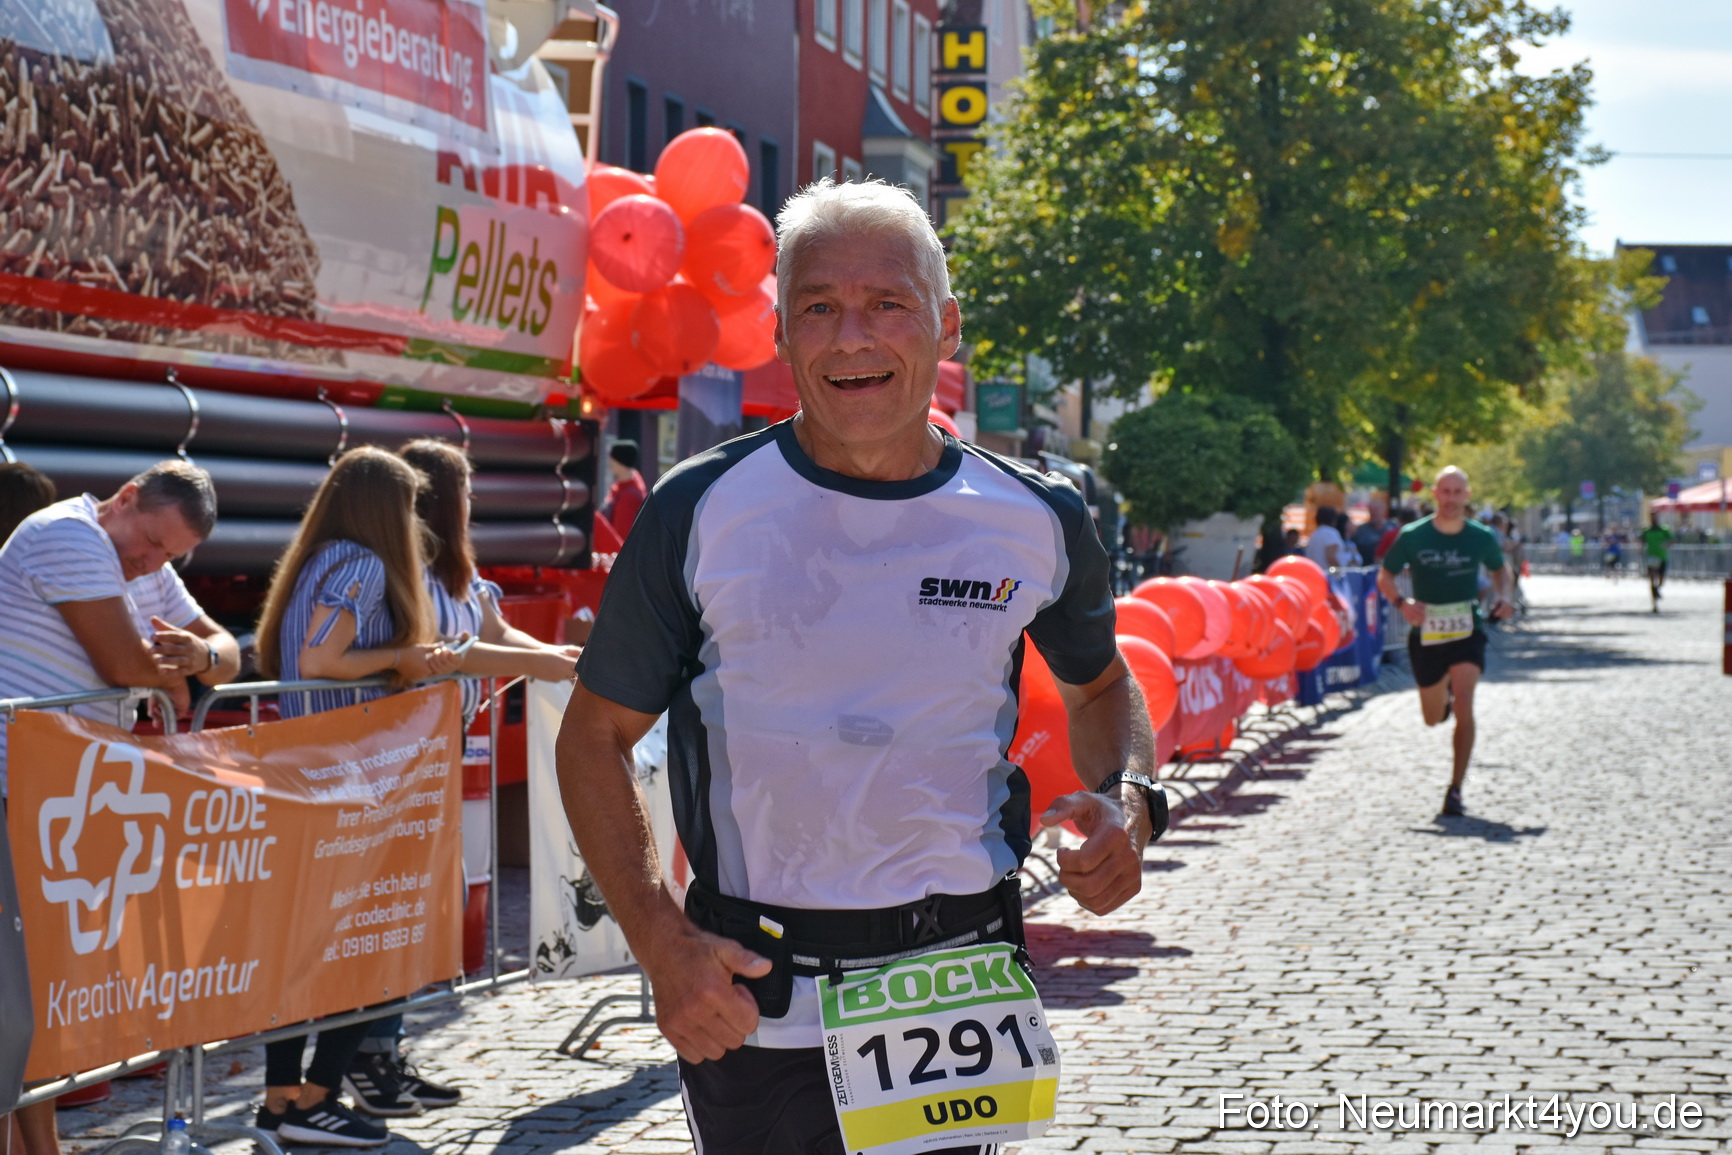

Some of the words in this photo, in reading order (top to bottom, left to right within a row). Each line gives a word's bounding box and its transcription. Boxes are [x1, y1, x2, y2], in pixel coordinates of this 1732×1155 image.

[278, 0, 474, 110] Energieberatung
[421, 205, 558, 336] Pellets
[919, 577, 992, 600] swn
[918, 597, 967, 608] stadtwerke
[969, 600, 1007, 612] neumarkt
[361, 742, 419, 772] moderner
[183, 787, 267, 836] CODE
[175, 836, 277, 889] CLINIC
[373, 873, 399, 897] sich
[400, 871, 418, 891] bei
[355, 896, 426, 927] codeclinic.de
[342, 932, 380, 958] 09181
[47, 956, 260, 1029] KreativAgentur
[842, 955, 1016, 1014] BOCK
[1029, 1016, 1039, 1027] C
[856, 1014, 1034, 1092] 1291
[922, 1095, 998, 1126] UDO
